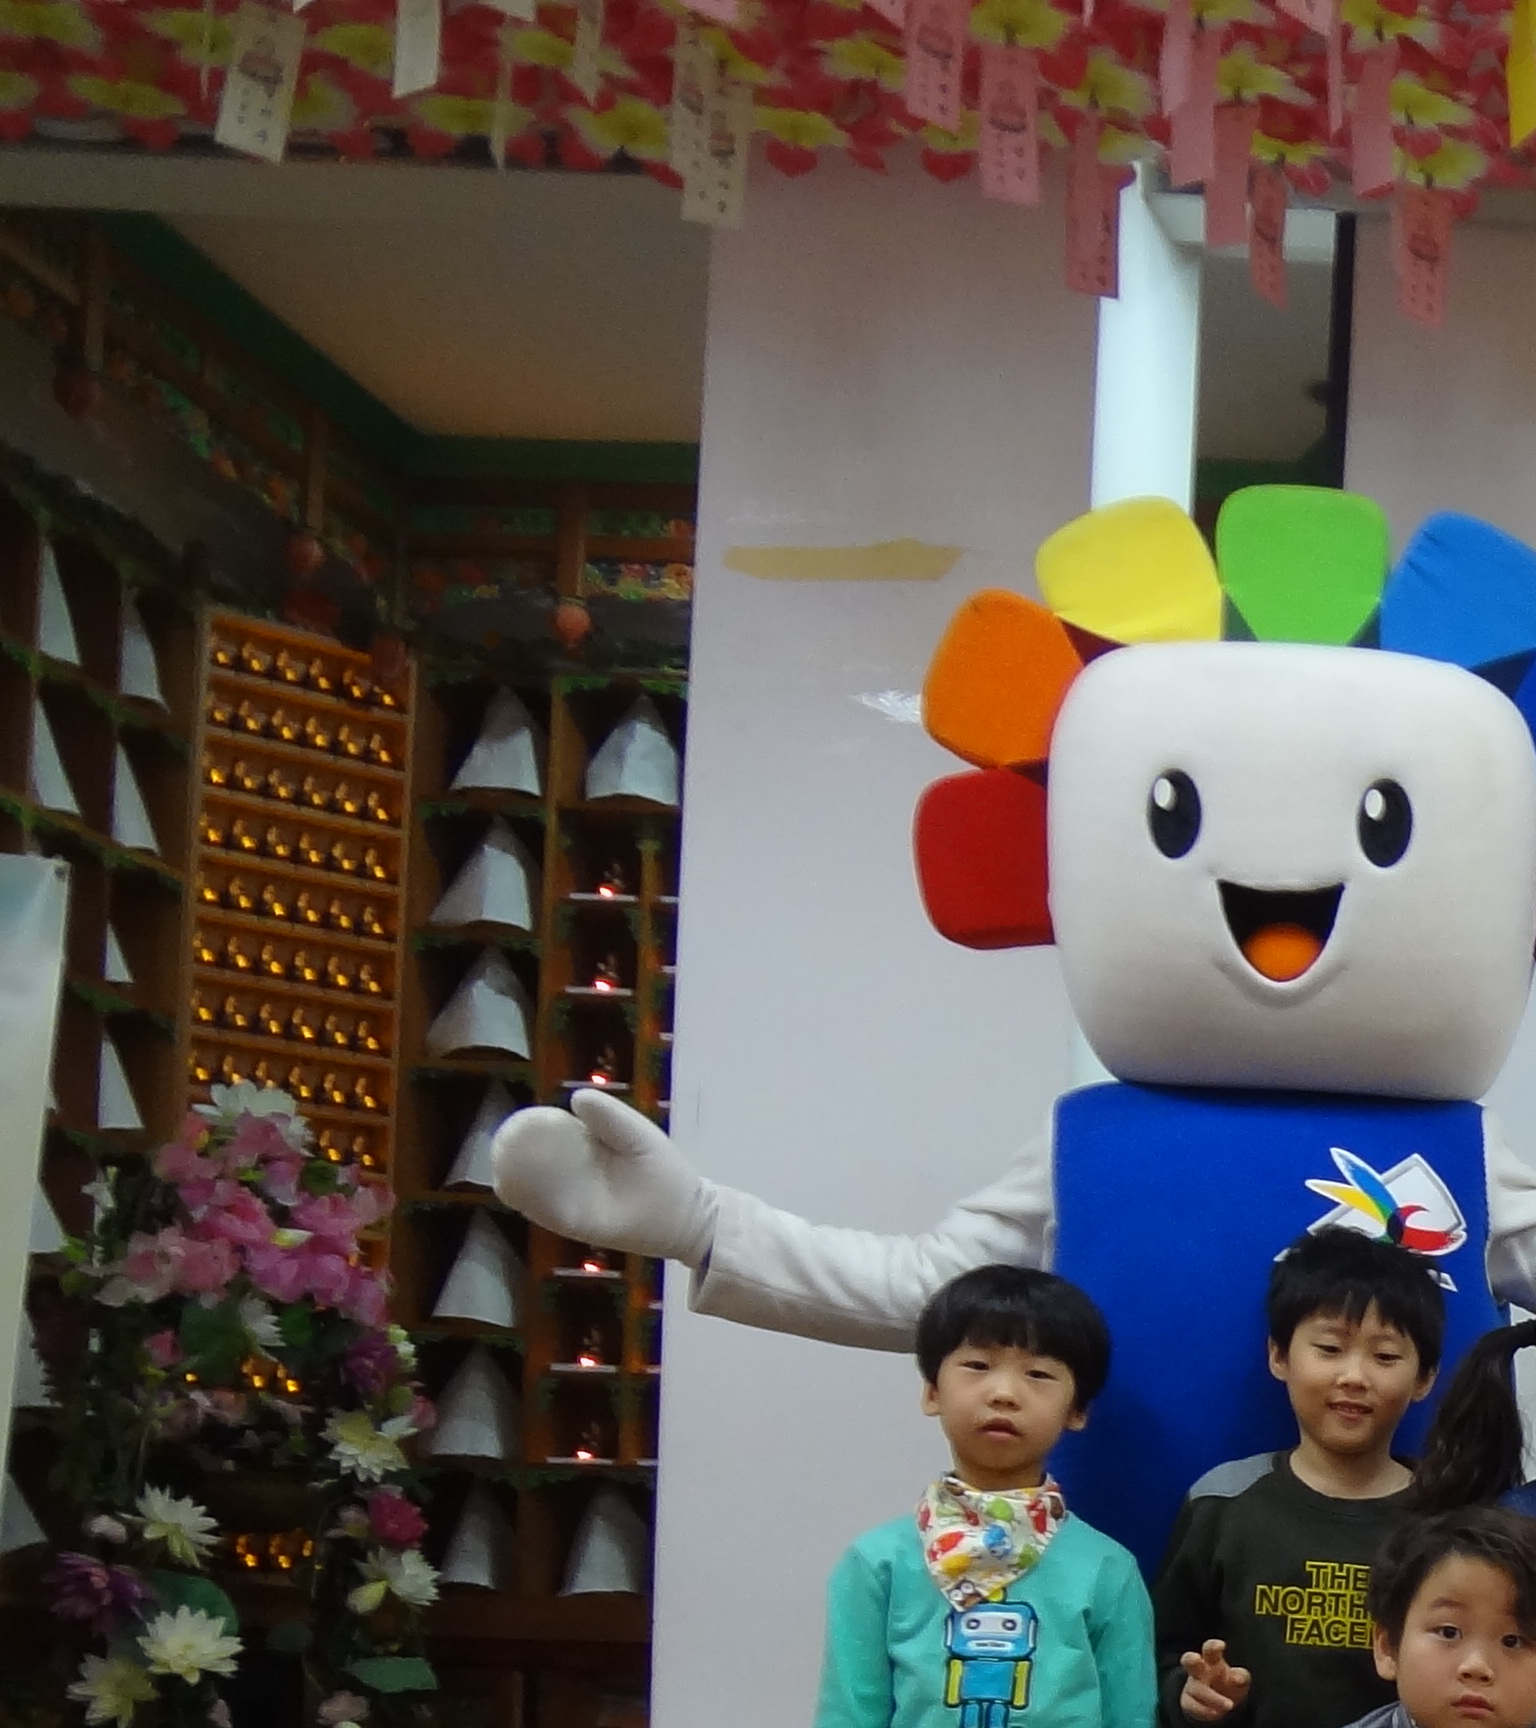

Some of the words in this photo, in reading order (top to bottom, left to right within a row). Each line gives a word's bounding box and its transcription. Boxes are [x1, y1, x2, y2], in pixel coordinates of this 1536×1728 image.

[1305, 1561, 1370, 1589] THE
[1255, 1584, 1371, 1619] NORTH
[1285, 1616, 1373, 1649] FACE
